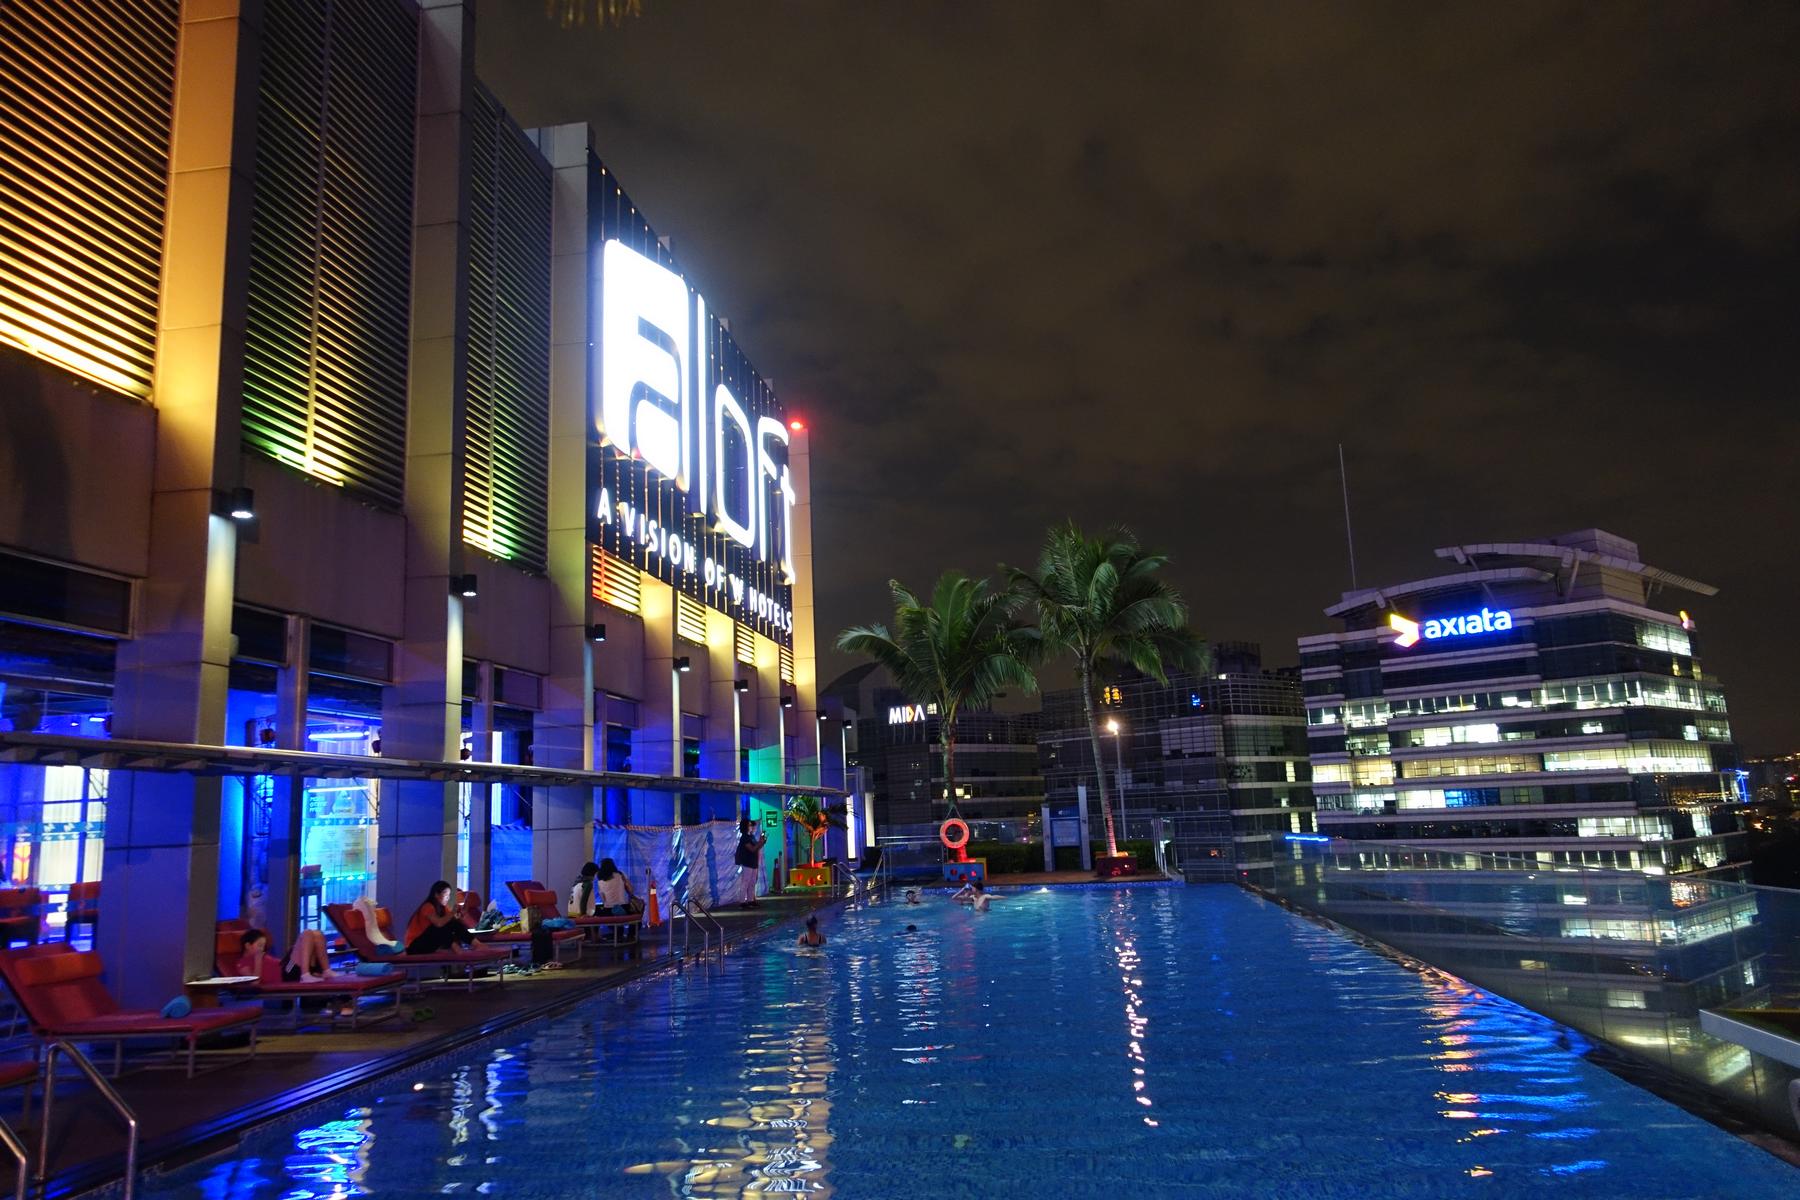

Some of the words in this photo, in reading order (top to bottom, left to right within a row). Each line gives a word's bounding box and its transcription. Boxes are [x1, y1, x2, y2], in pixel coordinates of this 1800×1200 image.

[597, 487, 612, 525] A
[619, 501, 695, 574] VISION
[704, 557, 725, 591] OF
[729, 573, 744, 605] W
[749, 586, 792, 634] HOTELS
[1424, 607, 1513, 639] axiata
[888, 704, 926, 725] MIDA
